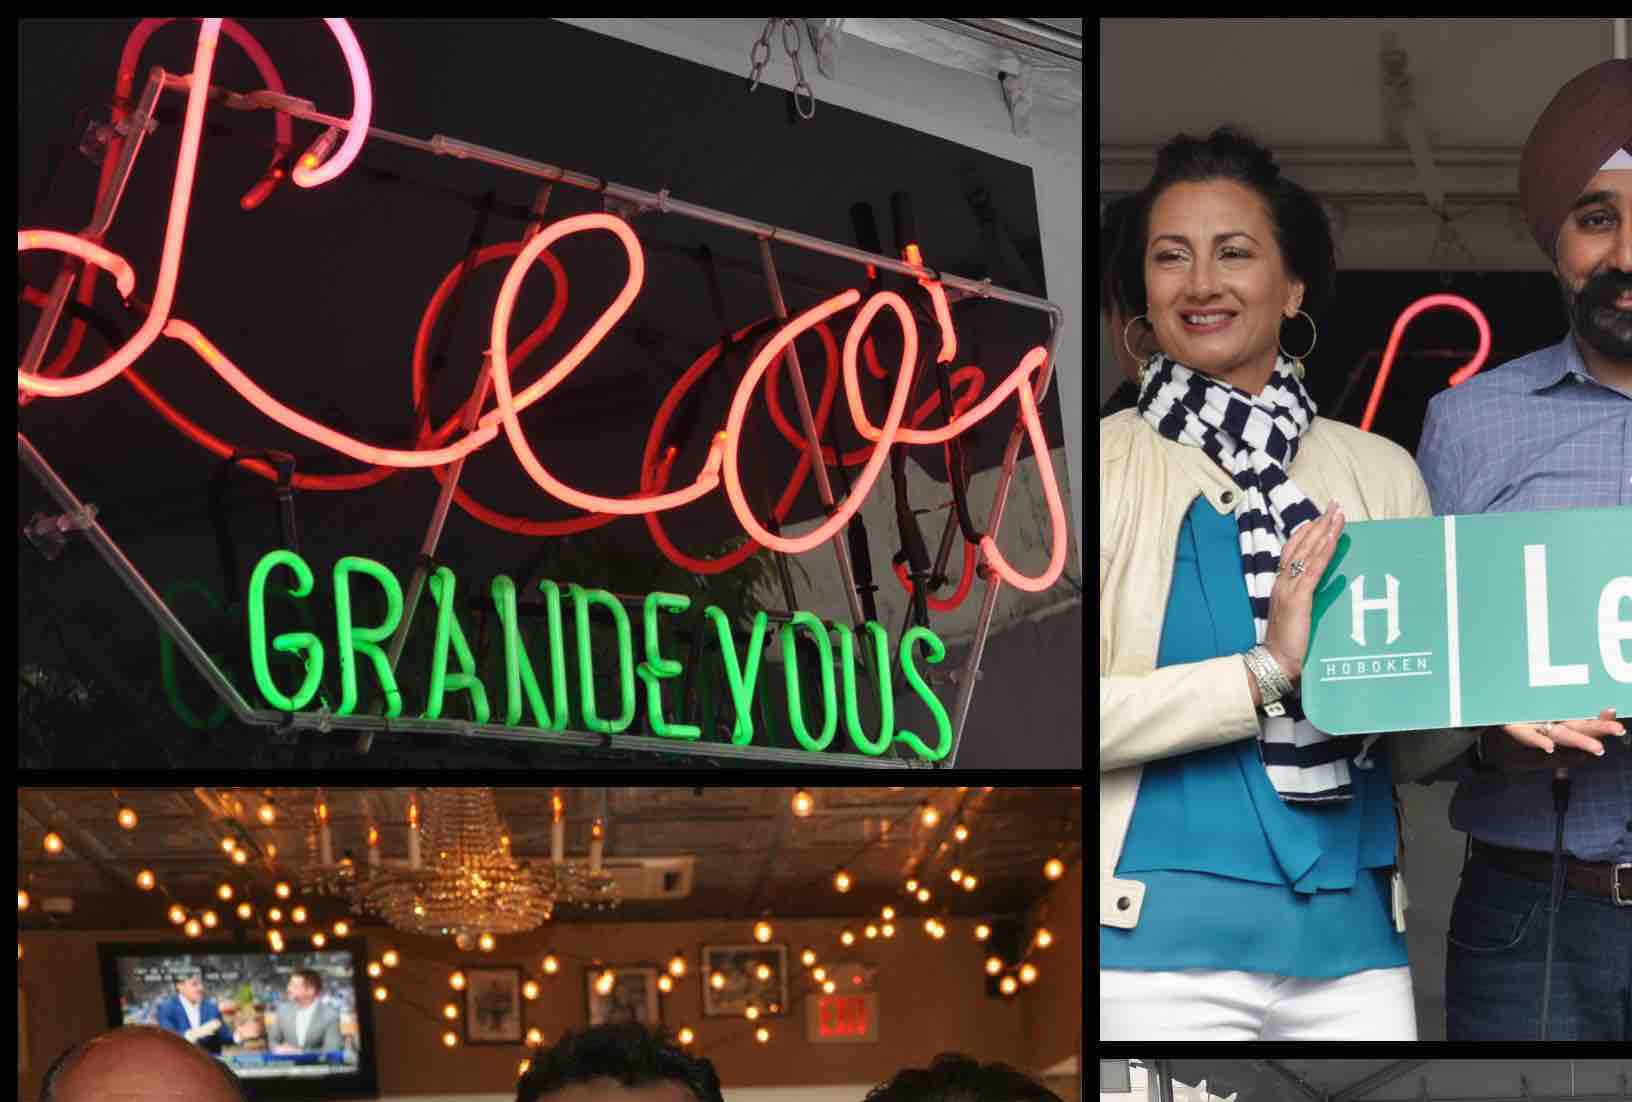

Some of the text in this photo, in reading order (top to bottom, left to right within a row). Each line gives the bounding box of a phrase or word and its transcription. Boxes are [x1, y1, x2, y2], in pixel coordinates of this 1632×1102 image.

[1349, 573, 1402, 646] H
[248, 549, 954, 762] GRANDEVOUS
[1326, 656, 1428, 677] HOBOKEN
